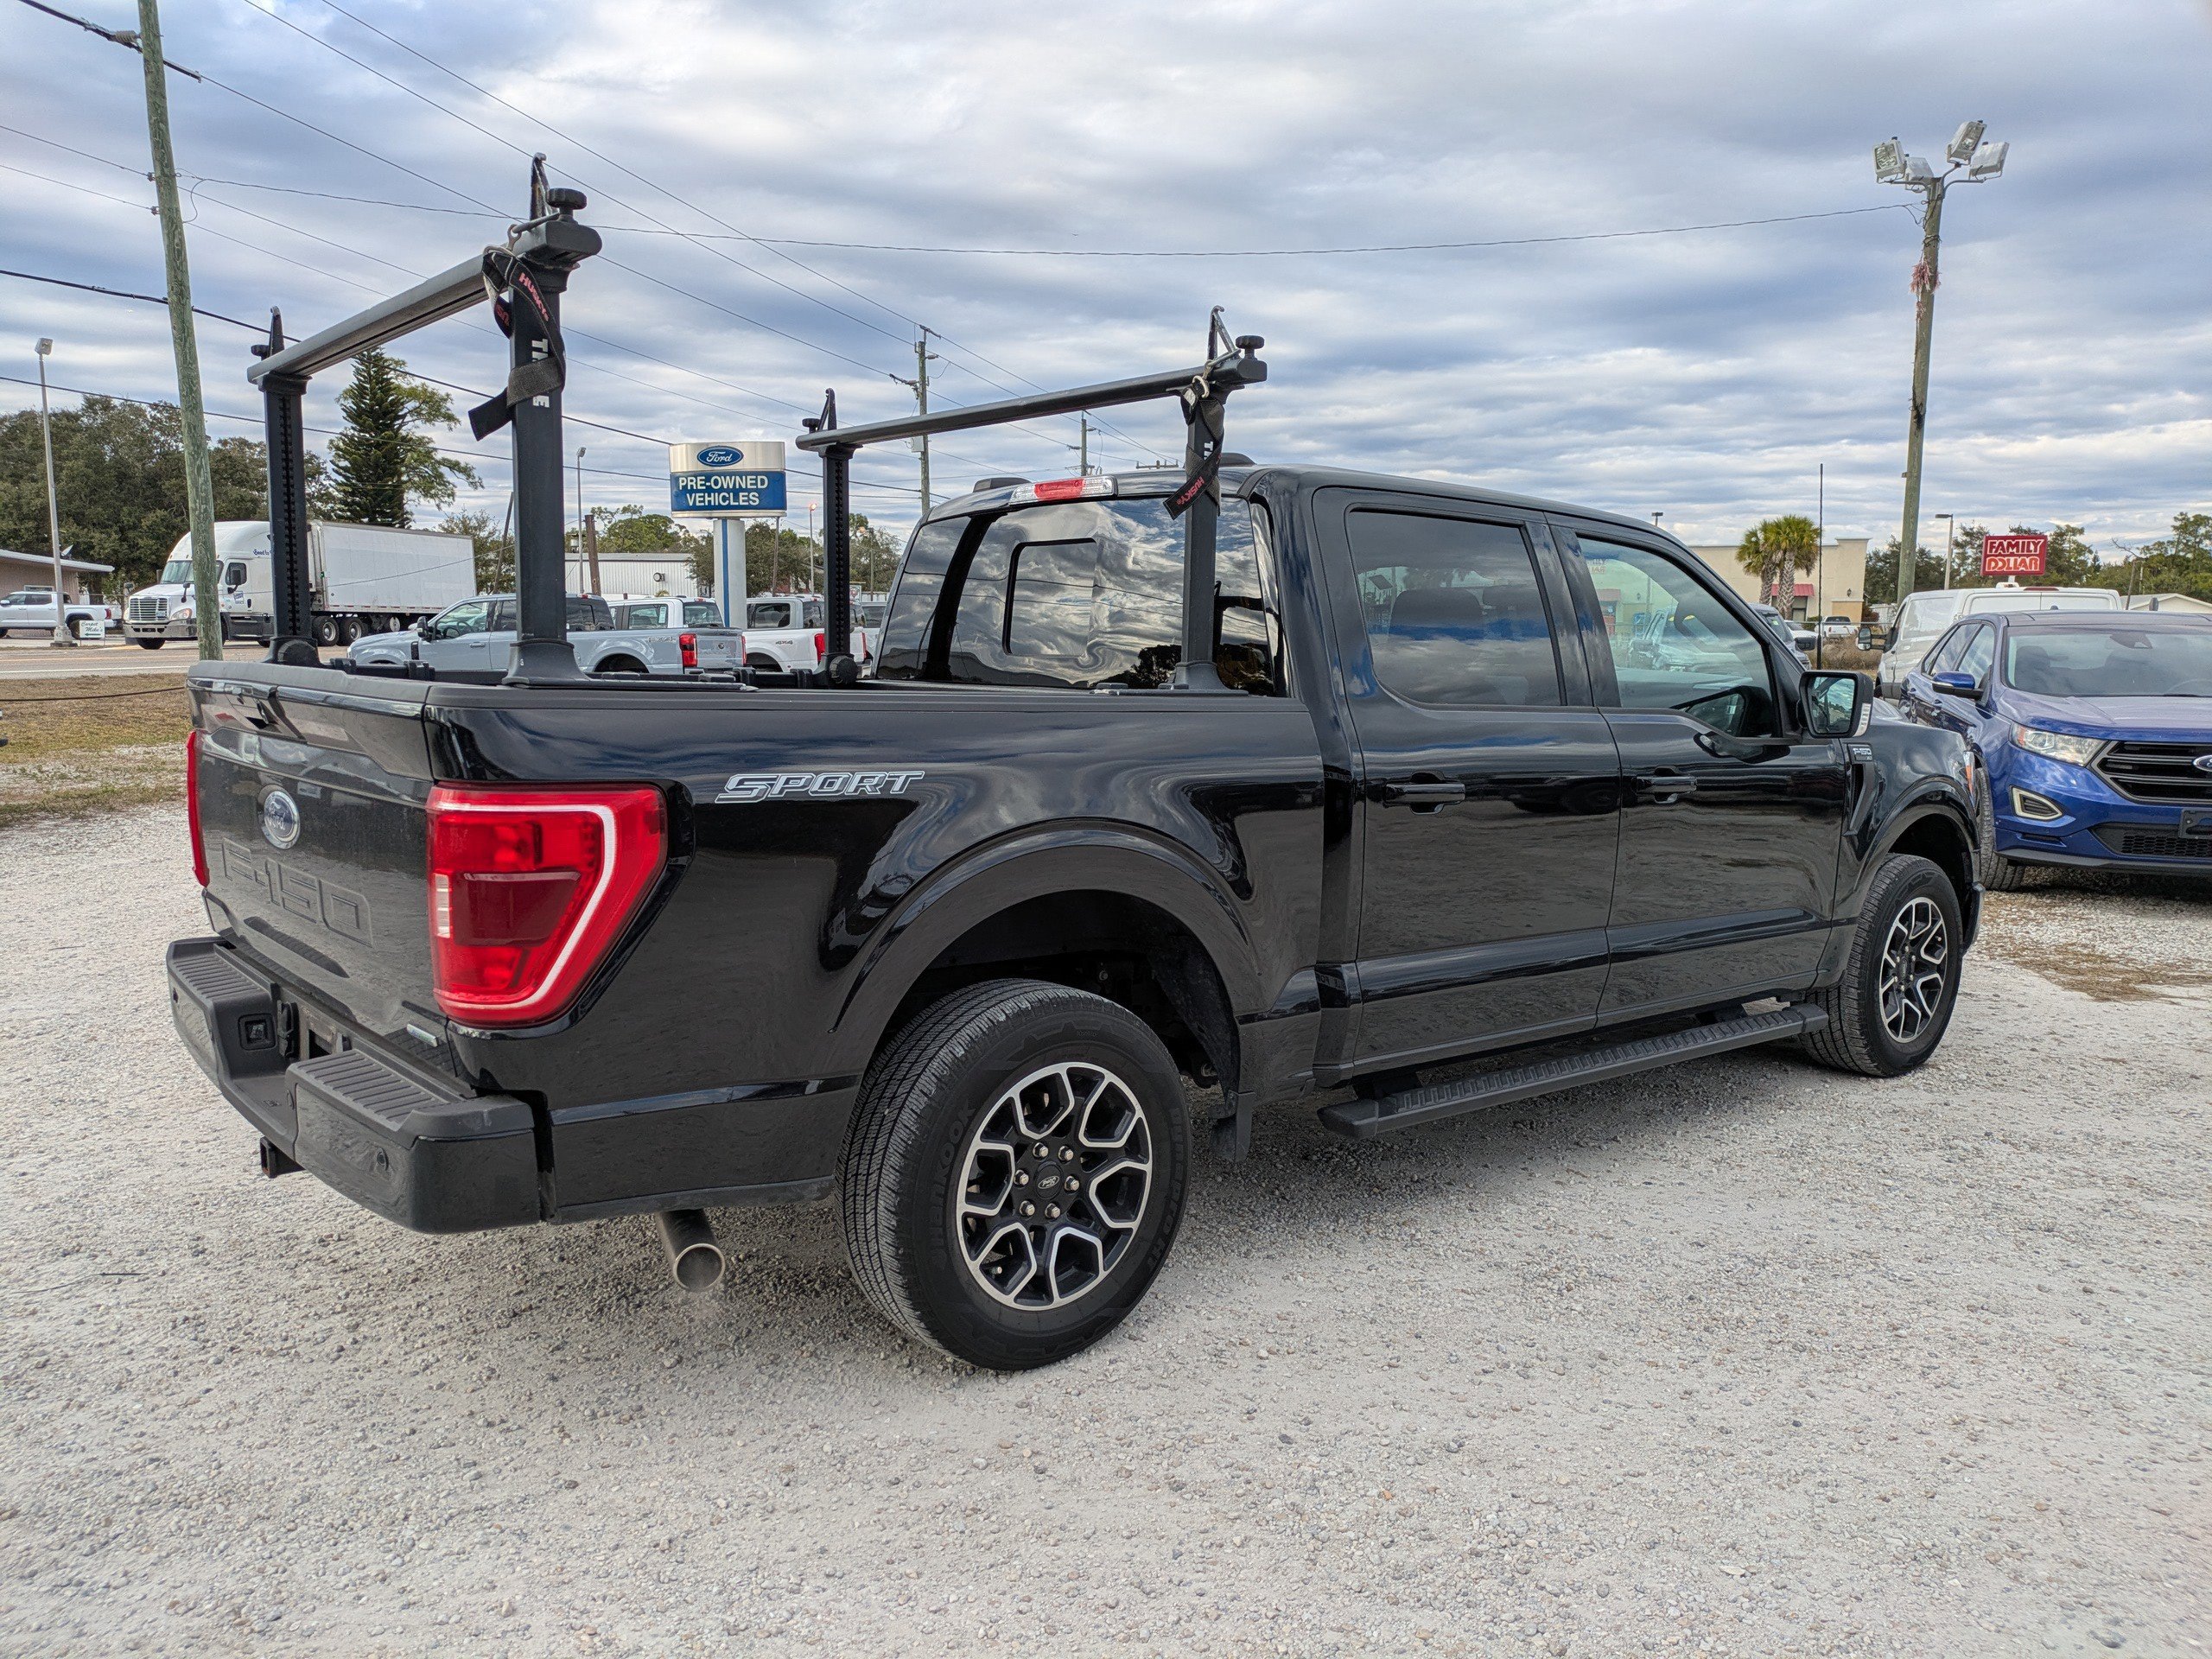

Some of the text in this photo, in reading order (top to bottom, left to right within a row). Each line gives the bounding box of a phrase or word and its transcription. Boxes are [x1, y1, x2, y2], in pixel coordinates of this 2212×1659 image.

[706, 451, 733, 462] Ford
[678, 475, 768, 490] PRE-OWNED
[1179, 476, 1205, 505] HUSKY
[686, 492, 760, 506] VEHICLES
[1986, 539, 2044, 554] FAMILY
[1986, 556, 2039, 571] DOLLAR
[715, 771, 925, 803] SPORT
[221, 836, 374, 949] F-150
